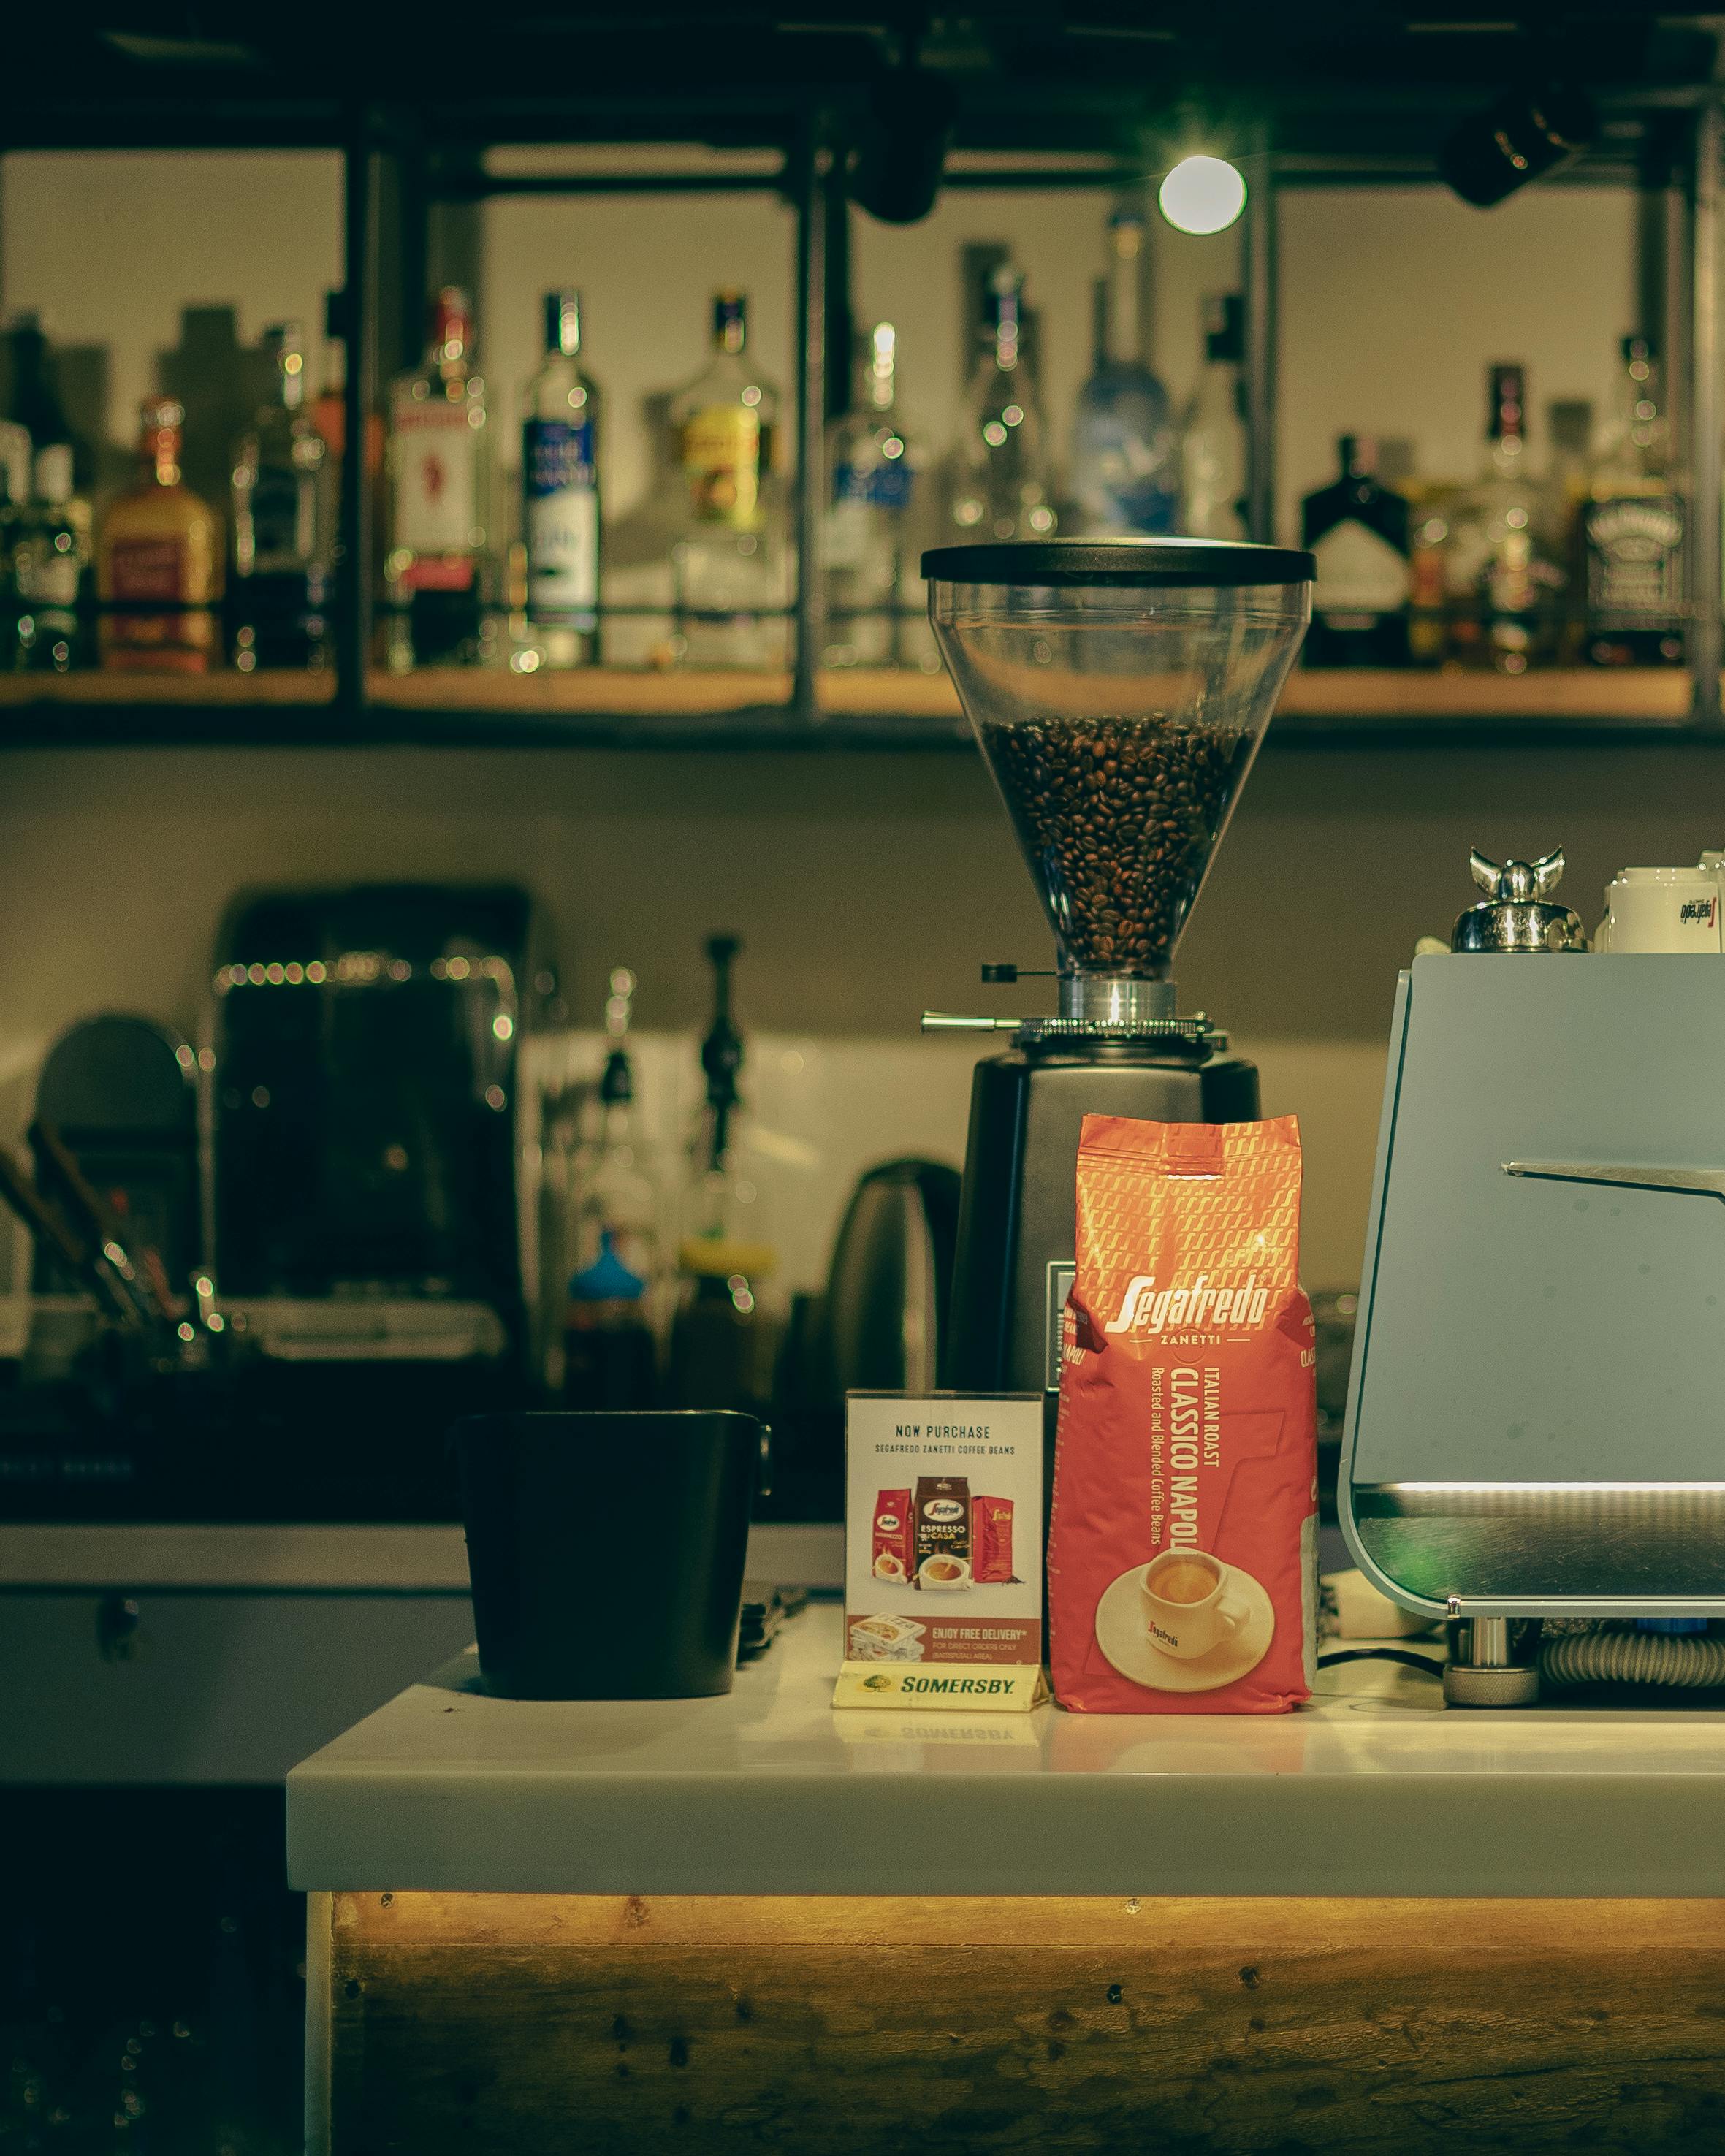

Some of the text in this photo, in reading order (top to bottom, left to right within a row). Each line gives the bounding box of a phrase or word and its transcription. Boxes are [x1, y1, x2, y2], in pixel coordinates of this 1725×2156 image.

[1104, 1274, 1268, 1334] Segafredo
[1160, 1335, 1221, 1345] ZANETTI
[1170, 1368, 1199, 1469] CLASSICO
[1203, 1367, 1219, 1468] ITALIAN ROAST
[896, 1425, 990, 1439] NOW PURCHASE
[875, 1444, 1015, 1455] SEGAFREDO ZANETTI COFFEE BEANS
[1151, 1367, 1165, 1545] Roasted and Blended Coffee Beans
[921, 1525, 966, 1534] ESPRESSO
[932, 1627, 959, 1639] ENJOY
[960, 1628, 980, 1640] FREE
[900, 1677, 1015, 1694] SOMERSBY
